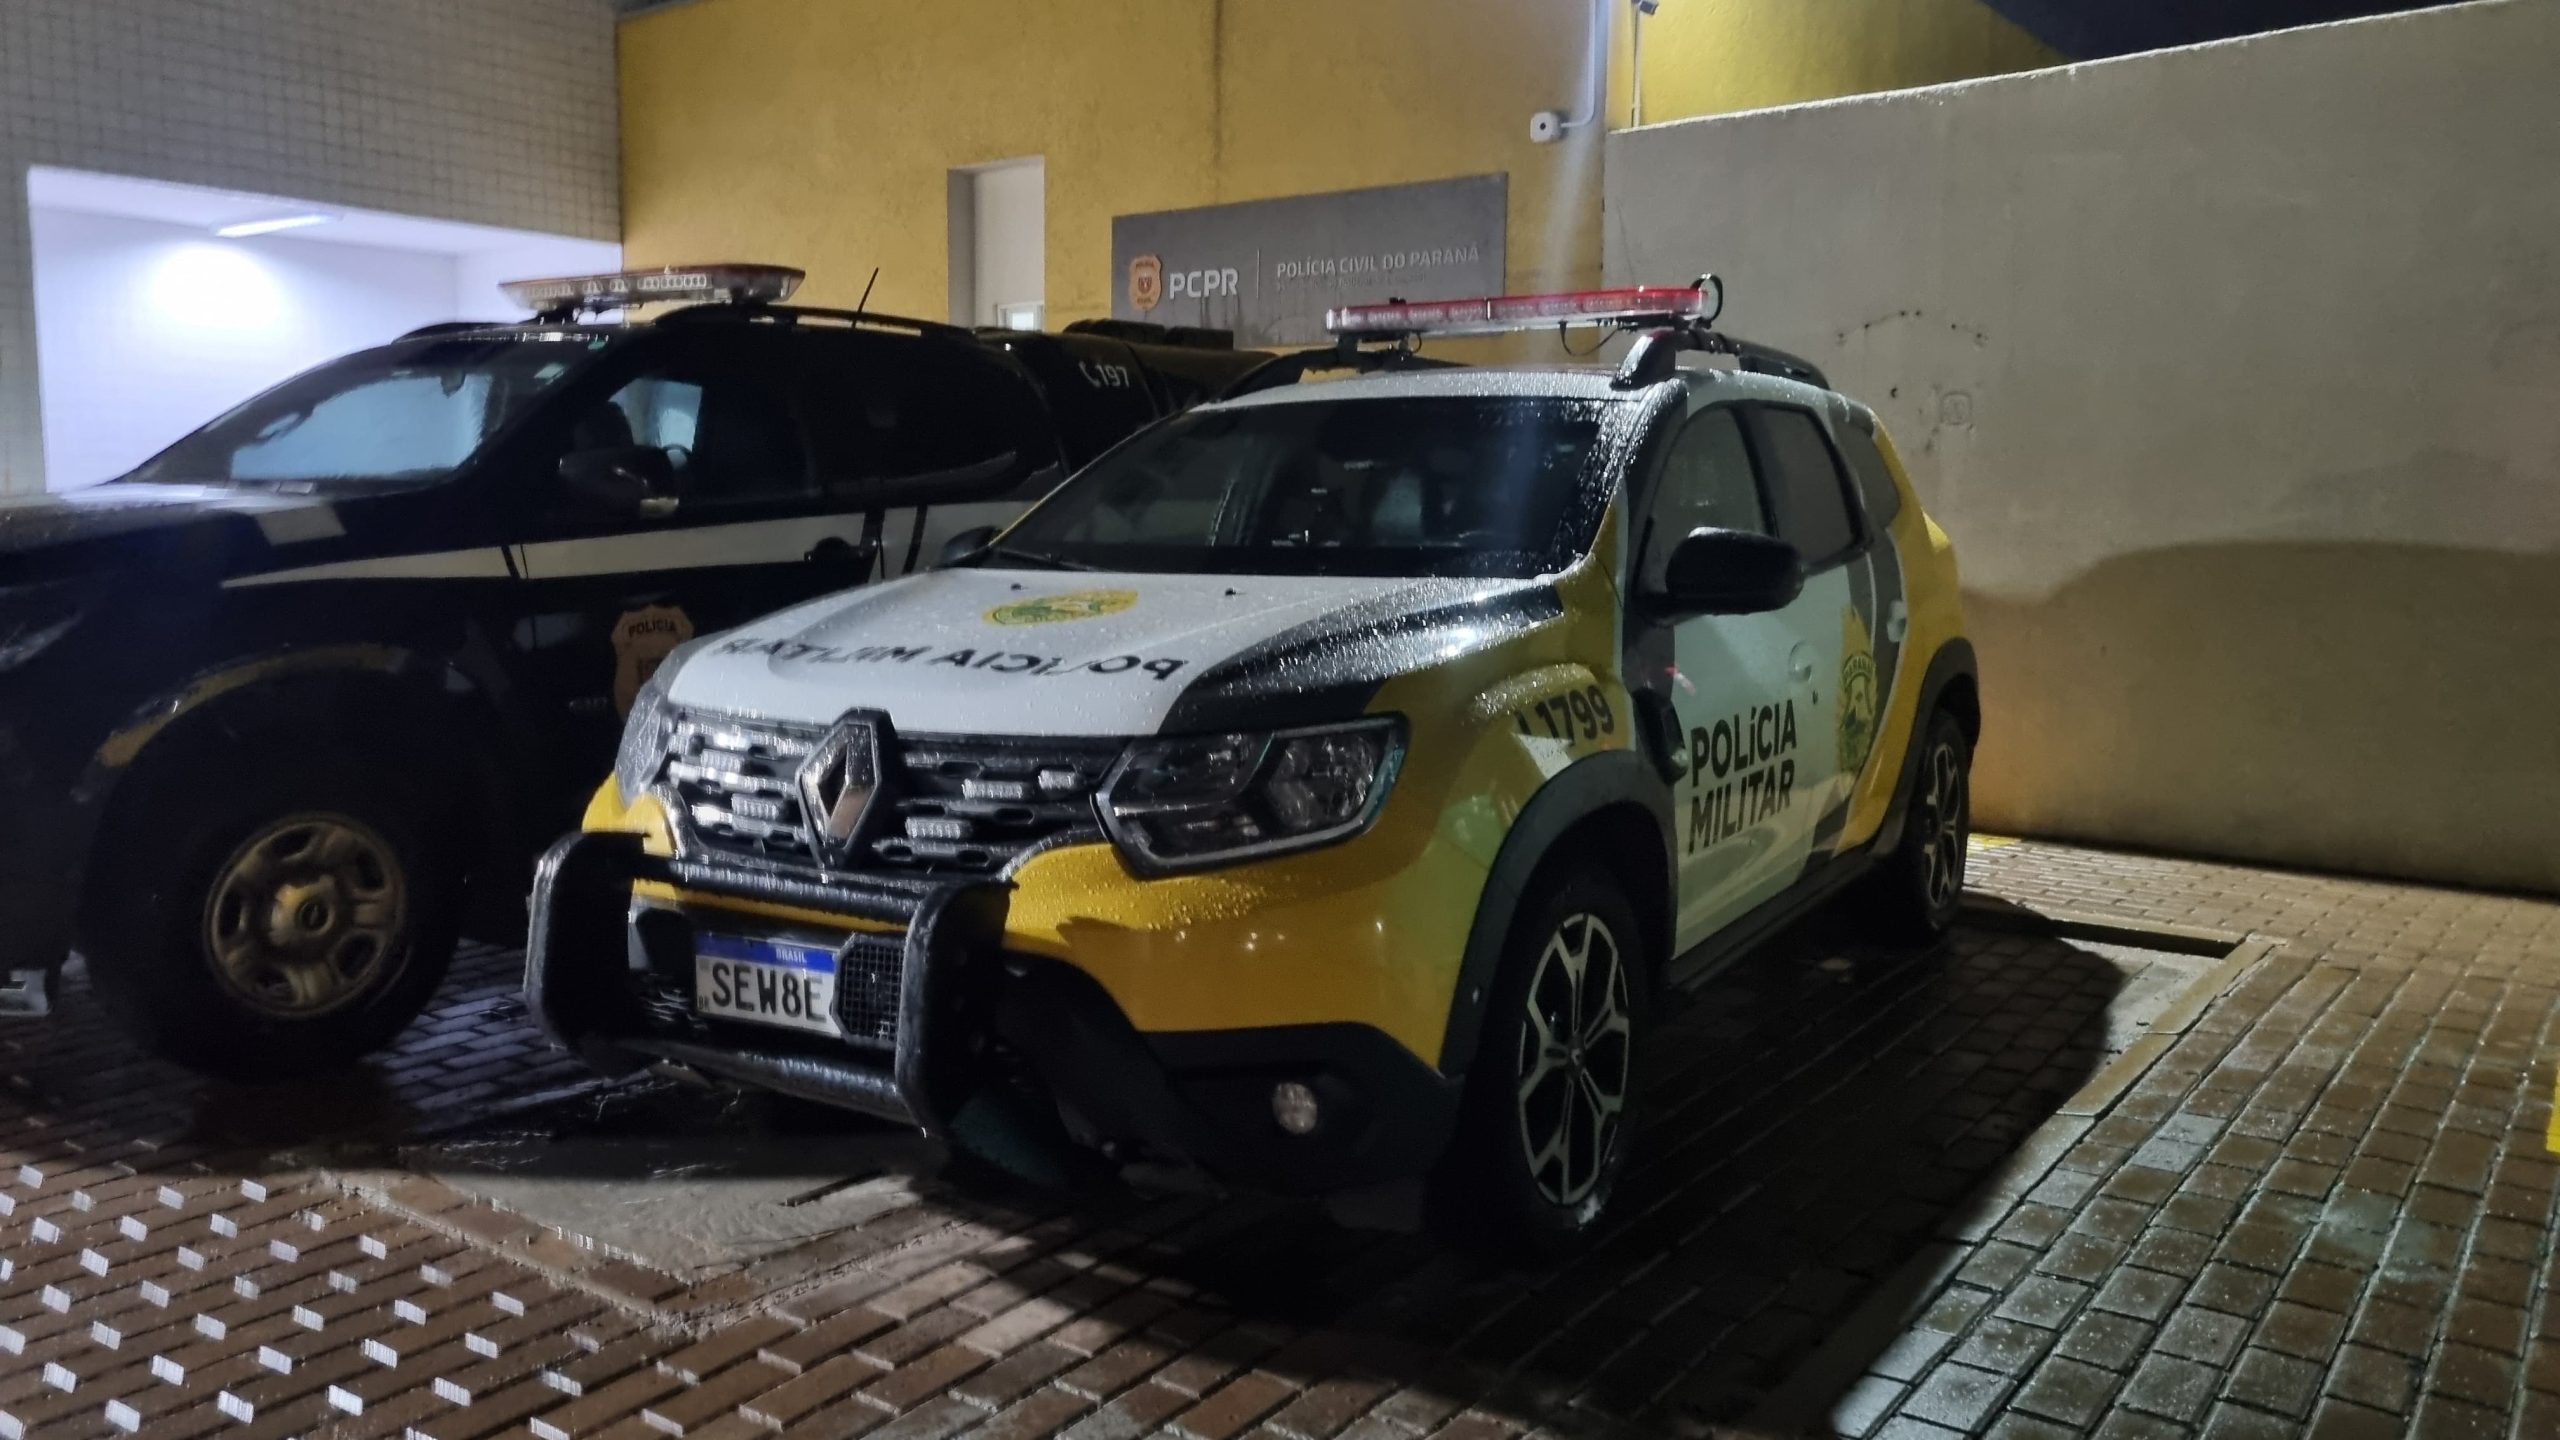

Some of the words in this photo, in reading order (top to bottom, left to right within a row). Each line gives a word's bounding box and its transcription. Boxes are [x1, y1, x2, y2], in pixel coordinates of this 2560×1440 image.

[1276, 255, 1337, 279] POLÍCIA
[1339, 255, 1377, 274] CIVIL
[1383, 252, 1406, 271] DO
[1409, 242, 1480, 267] PARANÁ
[1169, 267, 1239, 300] PCPR
[1094, 364, 1130, 388] 197
[1689, 699, 1797, 788] POLÍCIA
[1687, 758, 1795, 856] MILITAR
[775, 947, 808, 963] BRASIL
[711, 961, 833, 1023] SEW8E
